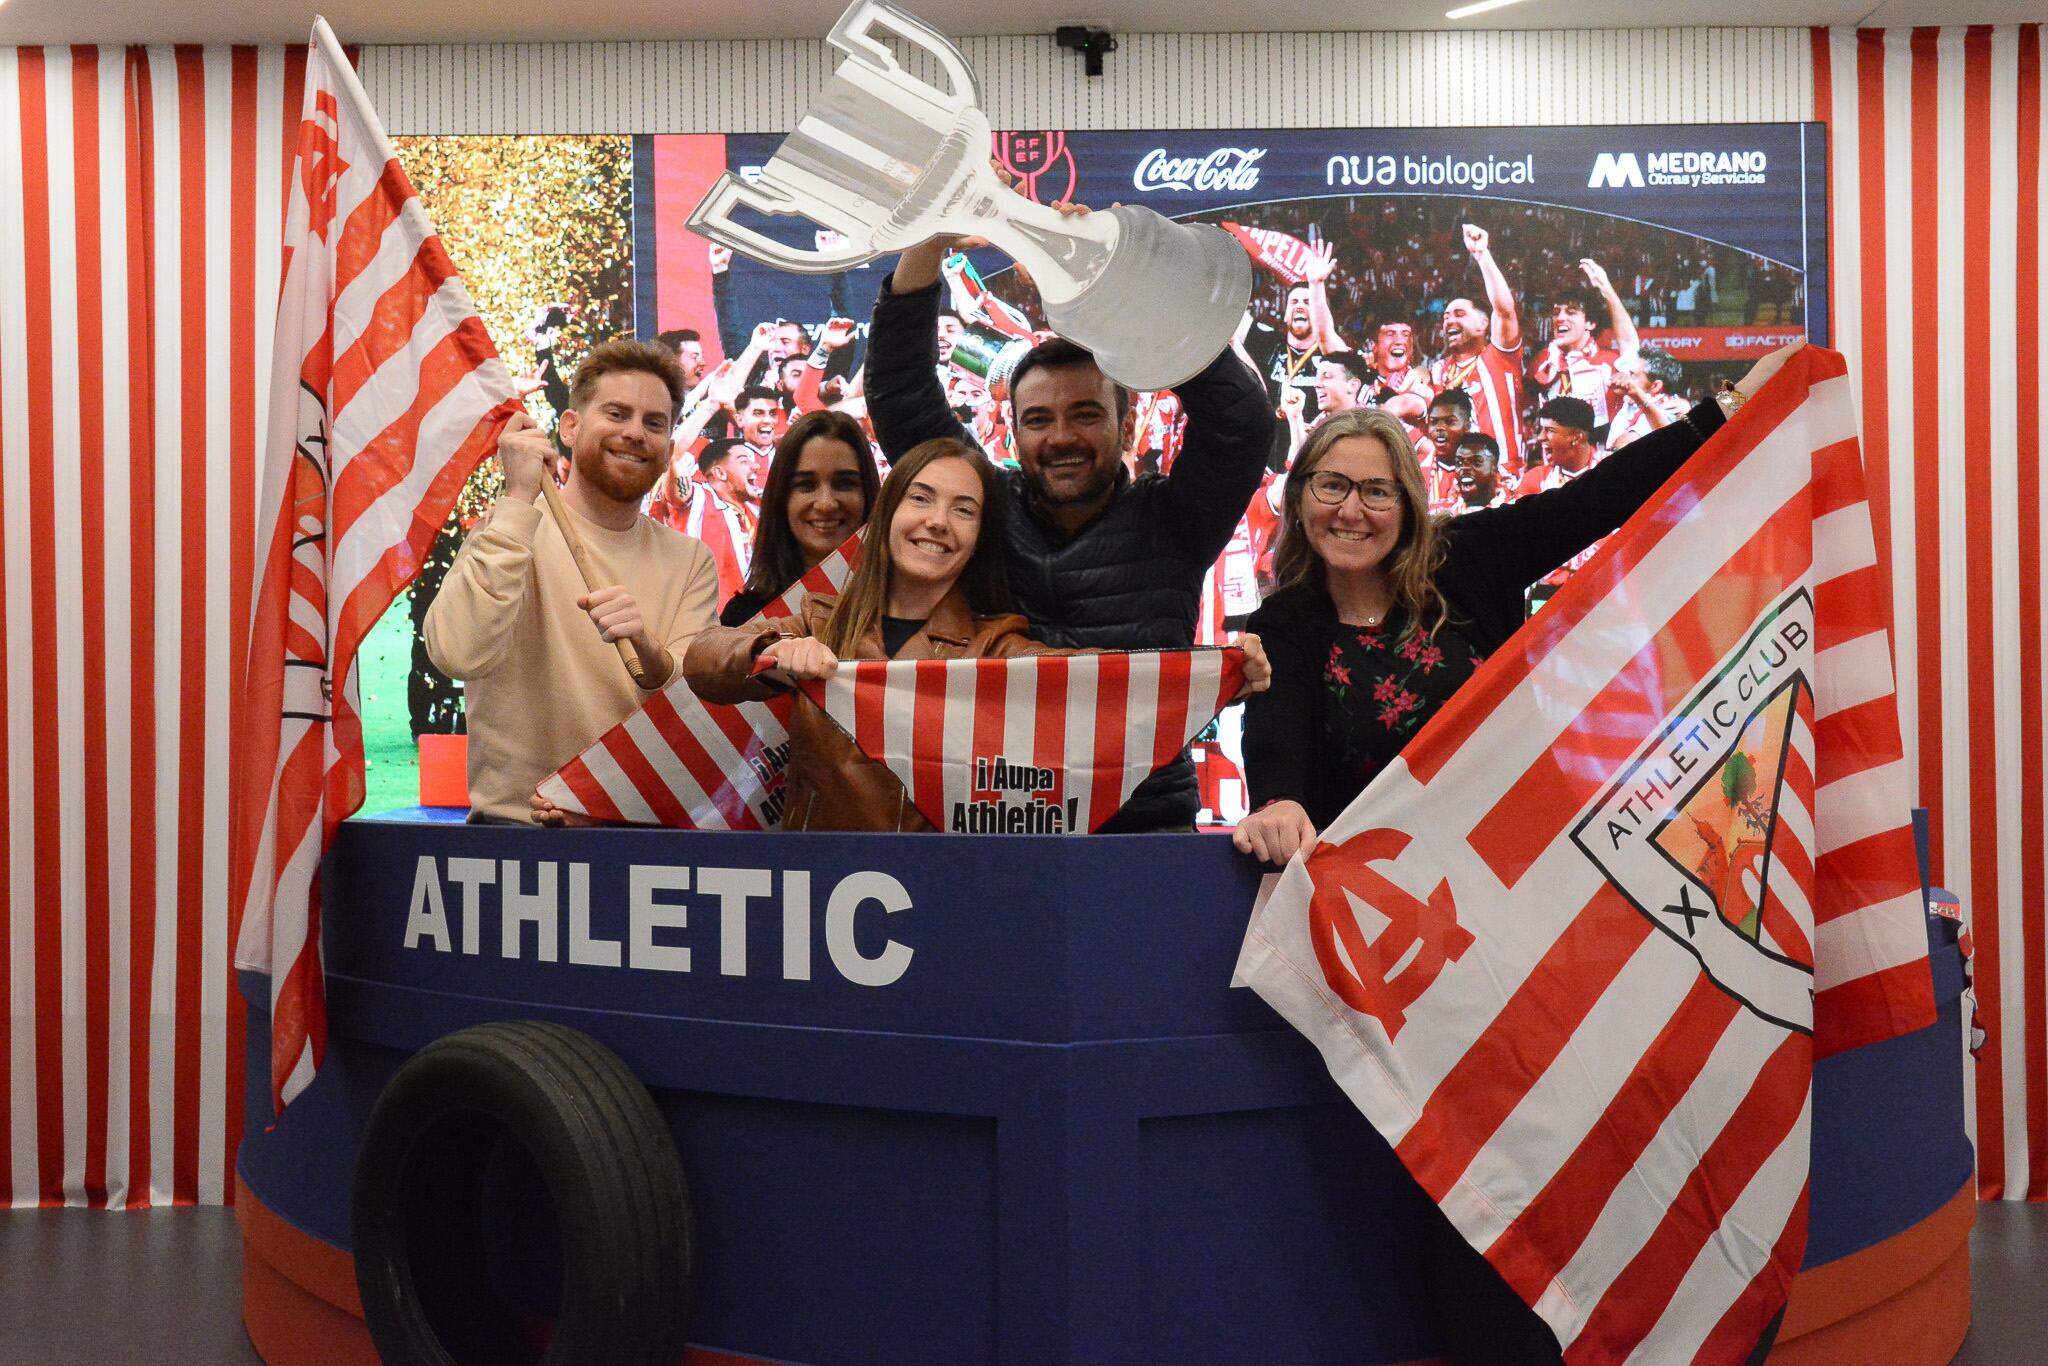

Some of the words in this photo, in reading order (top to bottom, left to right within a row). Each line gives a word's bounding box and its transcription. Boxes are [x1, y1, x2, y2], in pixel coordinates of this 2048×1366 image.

[1133, 147, 1268, 192] Coca-Cola
[1404, 153, 1535, 190] biological
[1648, 151, 1767, 173] MEDRANO
[1648, 172, 1690, 185] Obras
[1691, 174, 1701, 187] y
[1701, 172, 1766, 185] Servicios
[1605, 699, 1738, 851] ATHLETIC
[1736, 620, 1810, 702] CLUB
[403, 855, 914, 987] ATHLETIC
